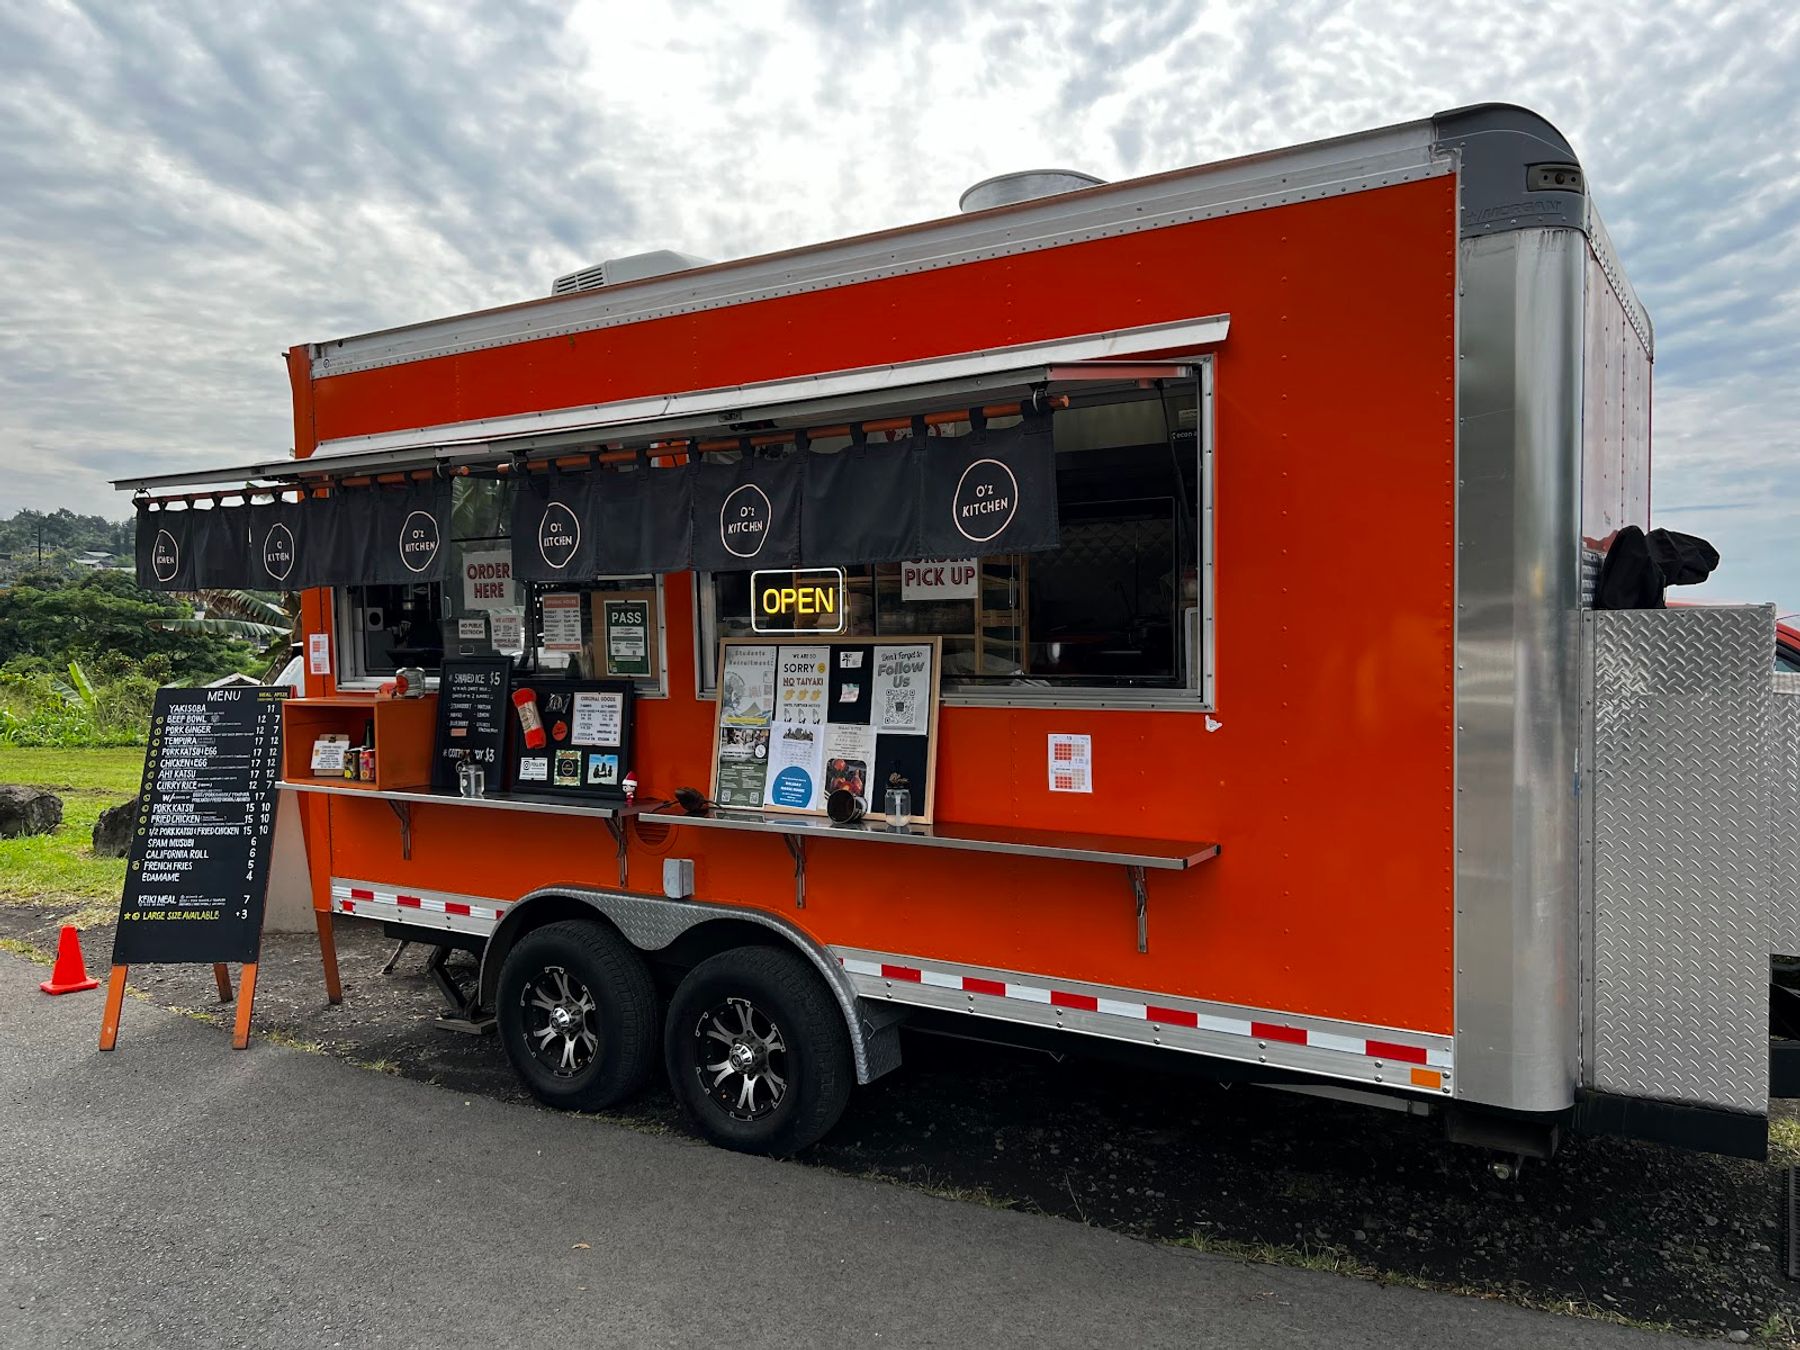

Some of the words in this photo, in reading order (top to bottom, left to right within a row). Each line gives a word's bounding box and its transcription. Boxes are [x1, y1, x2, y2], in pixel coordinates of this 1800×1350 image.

[962, 498, 1008, 517] KITCHEN
[728, 520, 762, 534] KITCHEN
[406, 542, 436, 552] KITCHEN
[466, 562, 510, 580] ORDER
[904, 566, 945, 586] PICK
[950, 566, 976, 585] UP
[474, 582, 504, 598] HERE
[762, 587, 834, 614] OPEN
[611, 612, 642, 624] PASS
[784, 664, 815, 673] SORRY
[878, 661, 925, 677] Follow
[475, 674, 485, 684] ICE
[490, 671, 501, 686] $5
[783, 677, 795, 686] NO
[796, 677, 824, 686] TAIYAKI
[892, 675, 911, 688] Us
[207, 690, 241, 702] MENU
[169, 704, 206, 714] YAKISOBA
[266, 704, 276, 714] 11
[167, 715, 186, 724] BEEF
[187, 715, 207, 724] BOWL
[257, 714, 266, 724] 12
[275, 715, 280, 724] 7
[165, 726, 184, 734] PORK
[185, 726, 212, 734] GINGER
[256, 726, 265, 734] 12
[273, 726, 278, 734] 7
[164, 737, 197, 746] TEMPURA
[255, 737, 264, 746] 17
[270, 737, 279, 745] 12
[161, 748, 180, 756] PORK
[180, 748, 201, 756] KATSU
[204, 747, 217, 755] EGG
[253, 748, 262, 757] 17
[269, 748, 278, 756] 12
[484, 748, 495, 762] $3
[160, 759, 190, 768] CHICKEN
[194, 759, 207, 767] EGG
[251, 759, 260, 768] 17
[267, 759, 276, 767] 12
[158, 770, 173, 779] AHI
[174, 770, 197, 778] KATSU
[250, 770, 260, 778] 17
[266, 770, 275, 778] 12
[156, 781, 180, 790] CURRY
[181, 781, 197, 789] RICE
[249, 781, 257, 789] 12
[255, 792, 265, 800] 17
[153, 804, 172, 813] PORK
[172, 804, 194, 812] KATSU
[246, 803, 255, 812] 15
[261, 802, 271, 812] 10
[151, 815, 171, 824] FRIED
[172, 815, 200, 823] CHICKEN
[245, 815, 253, 823] 15
[260, 814, 270, 823] 10
[159, 827, 175, 836] PORK
[176, 827, 193, 835] KATSU
[197, 827, 214, 835] FRIED
[215, 827, 239, 835] CHICKEN
[243, 826, 252, 835] 15
[259, 825, 268, 834] 10
[148, 839, 168, 848] SPAM
[169, 839, 195, 848] MUSUBI
[250, 837, 257, 846] 6
[146, 850, 189, 859] CALIFORNIA
[190, 850, 209, 859] ROLL
[249, 848, 256, 858] 6
[143, 862, 172, 870] FRENCH
[173, 862, 193, 870] FRIES
[248, 860, 255, 869] 5
[142, 873, 180, 882] EDAMAME
[245, 871, 253, 880] 4
[138, 895, 157, 904] KEIKI
[157, 895, 177, 904] MEAL
[244, 895, 251, 904] 7
[142, 912, 165, 920] LARGE
[167, 911, 182, 920] SIZE
[182, 910, 220, 920] AVAILABLE
